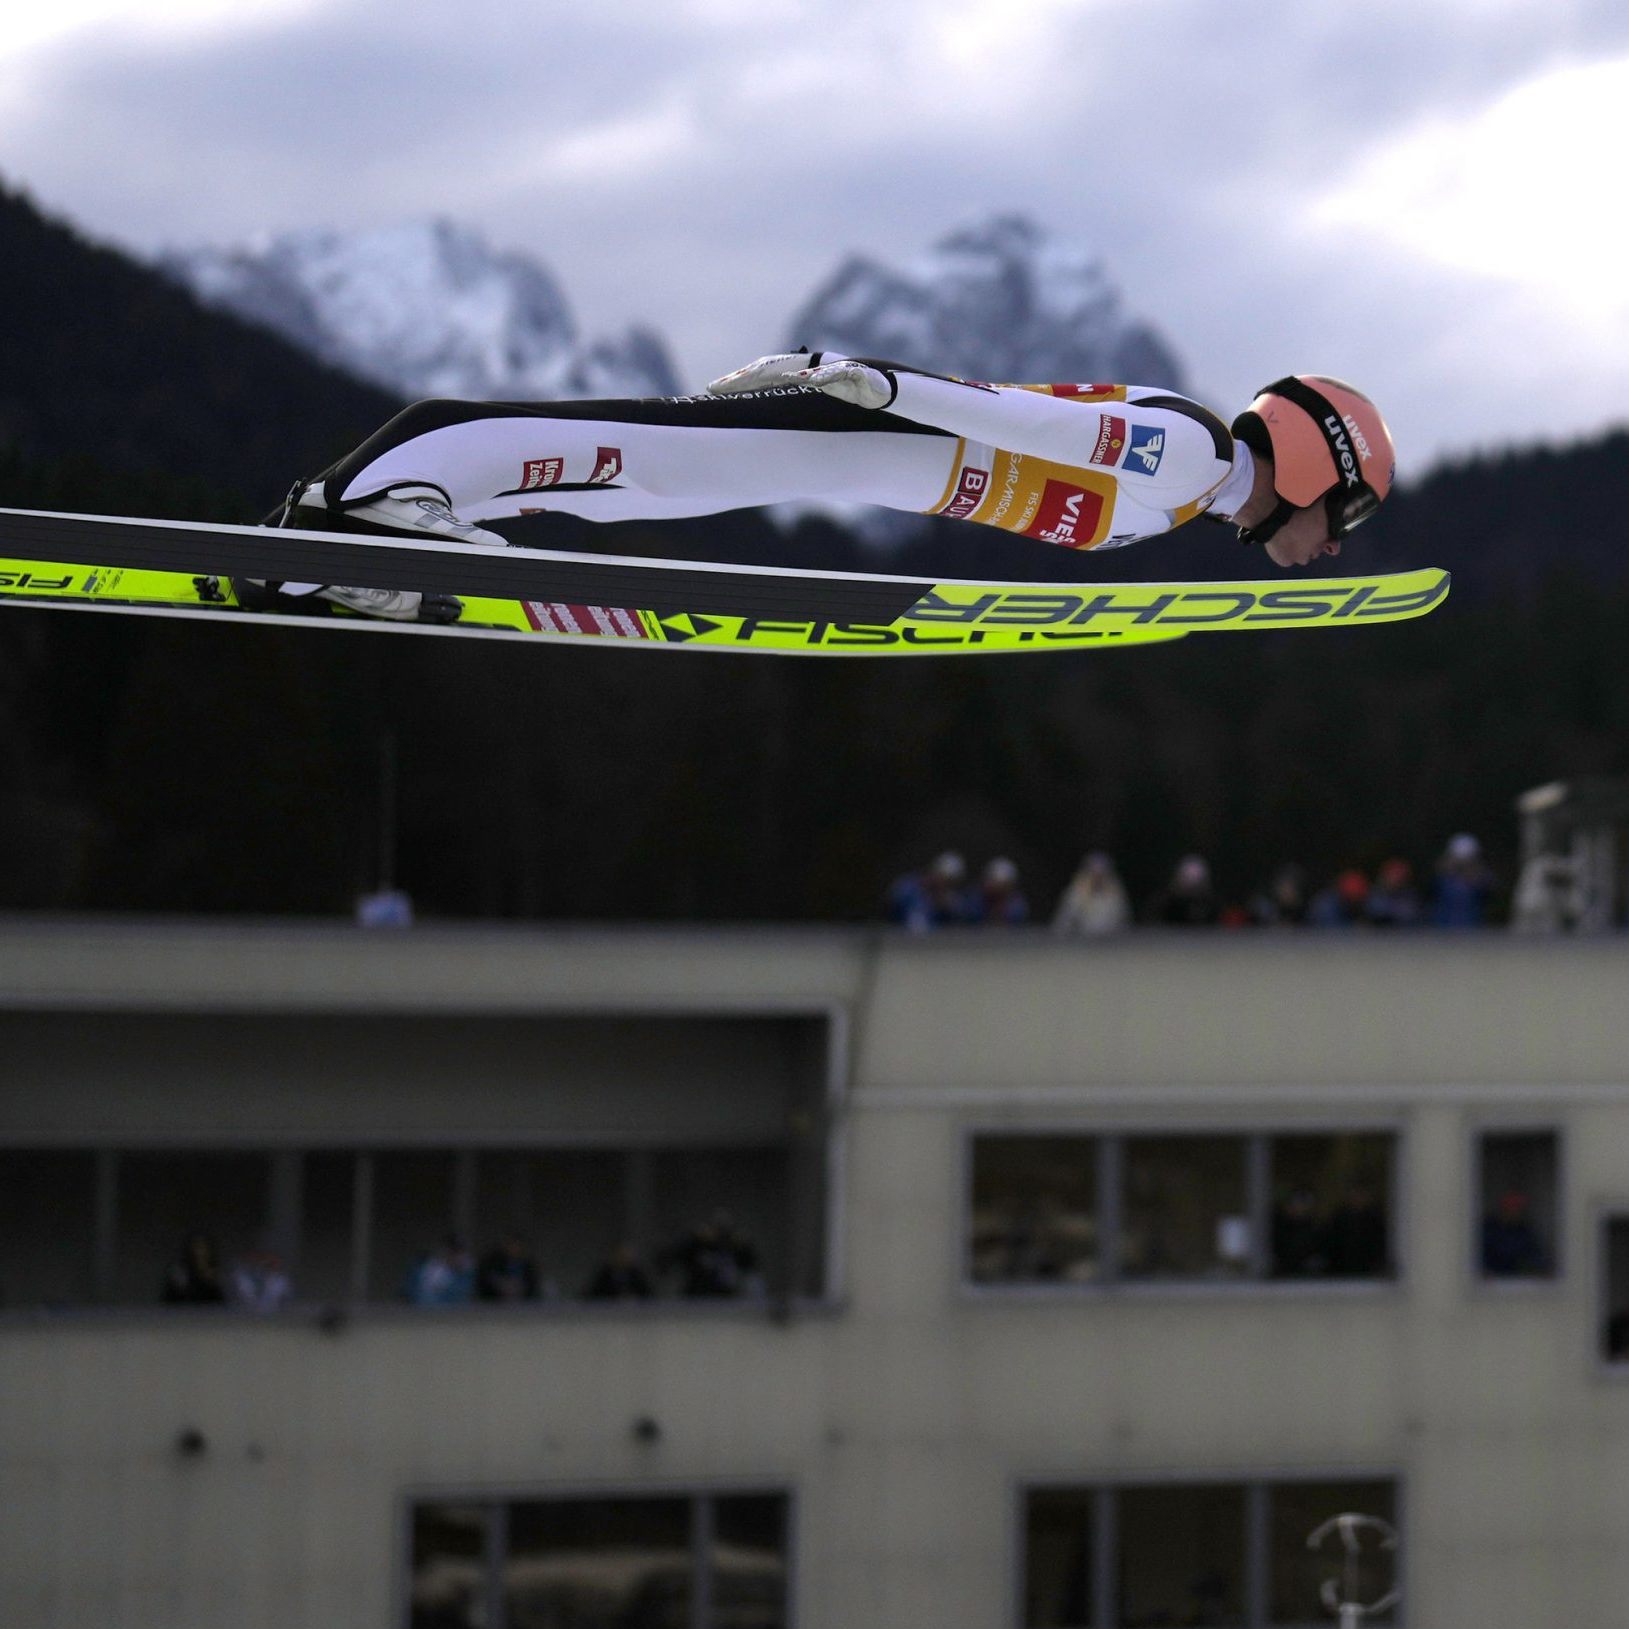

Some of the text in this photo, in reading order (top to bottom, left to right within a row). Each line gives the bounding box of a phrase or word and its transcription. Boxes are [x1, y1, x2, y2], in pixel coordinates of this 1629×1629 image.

[1091, 414, 1112, 464] HARGASSNER
[1324, 415, 1359, 488] uvex
[1341, 414, 1373, 461] uvex
[902, 571, 1450, 624] FISCHER
